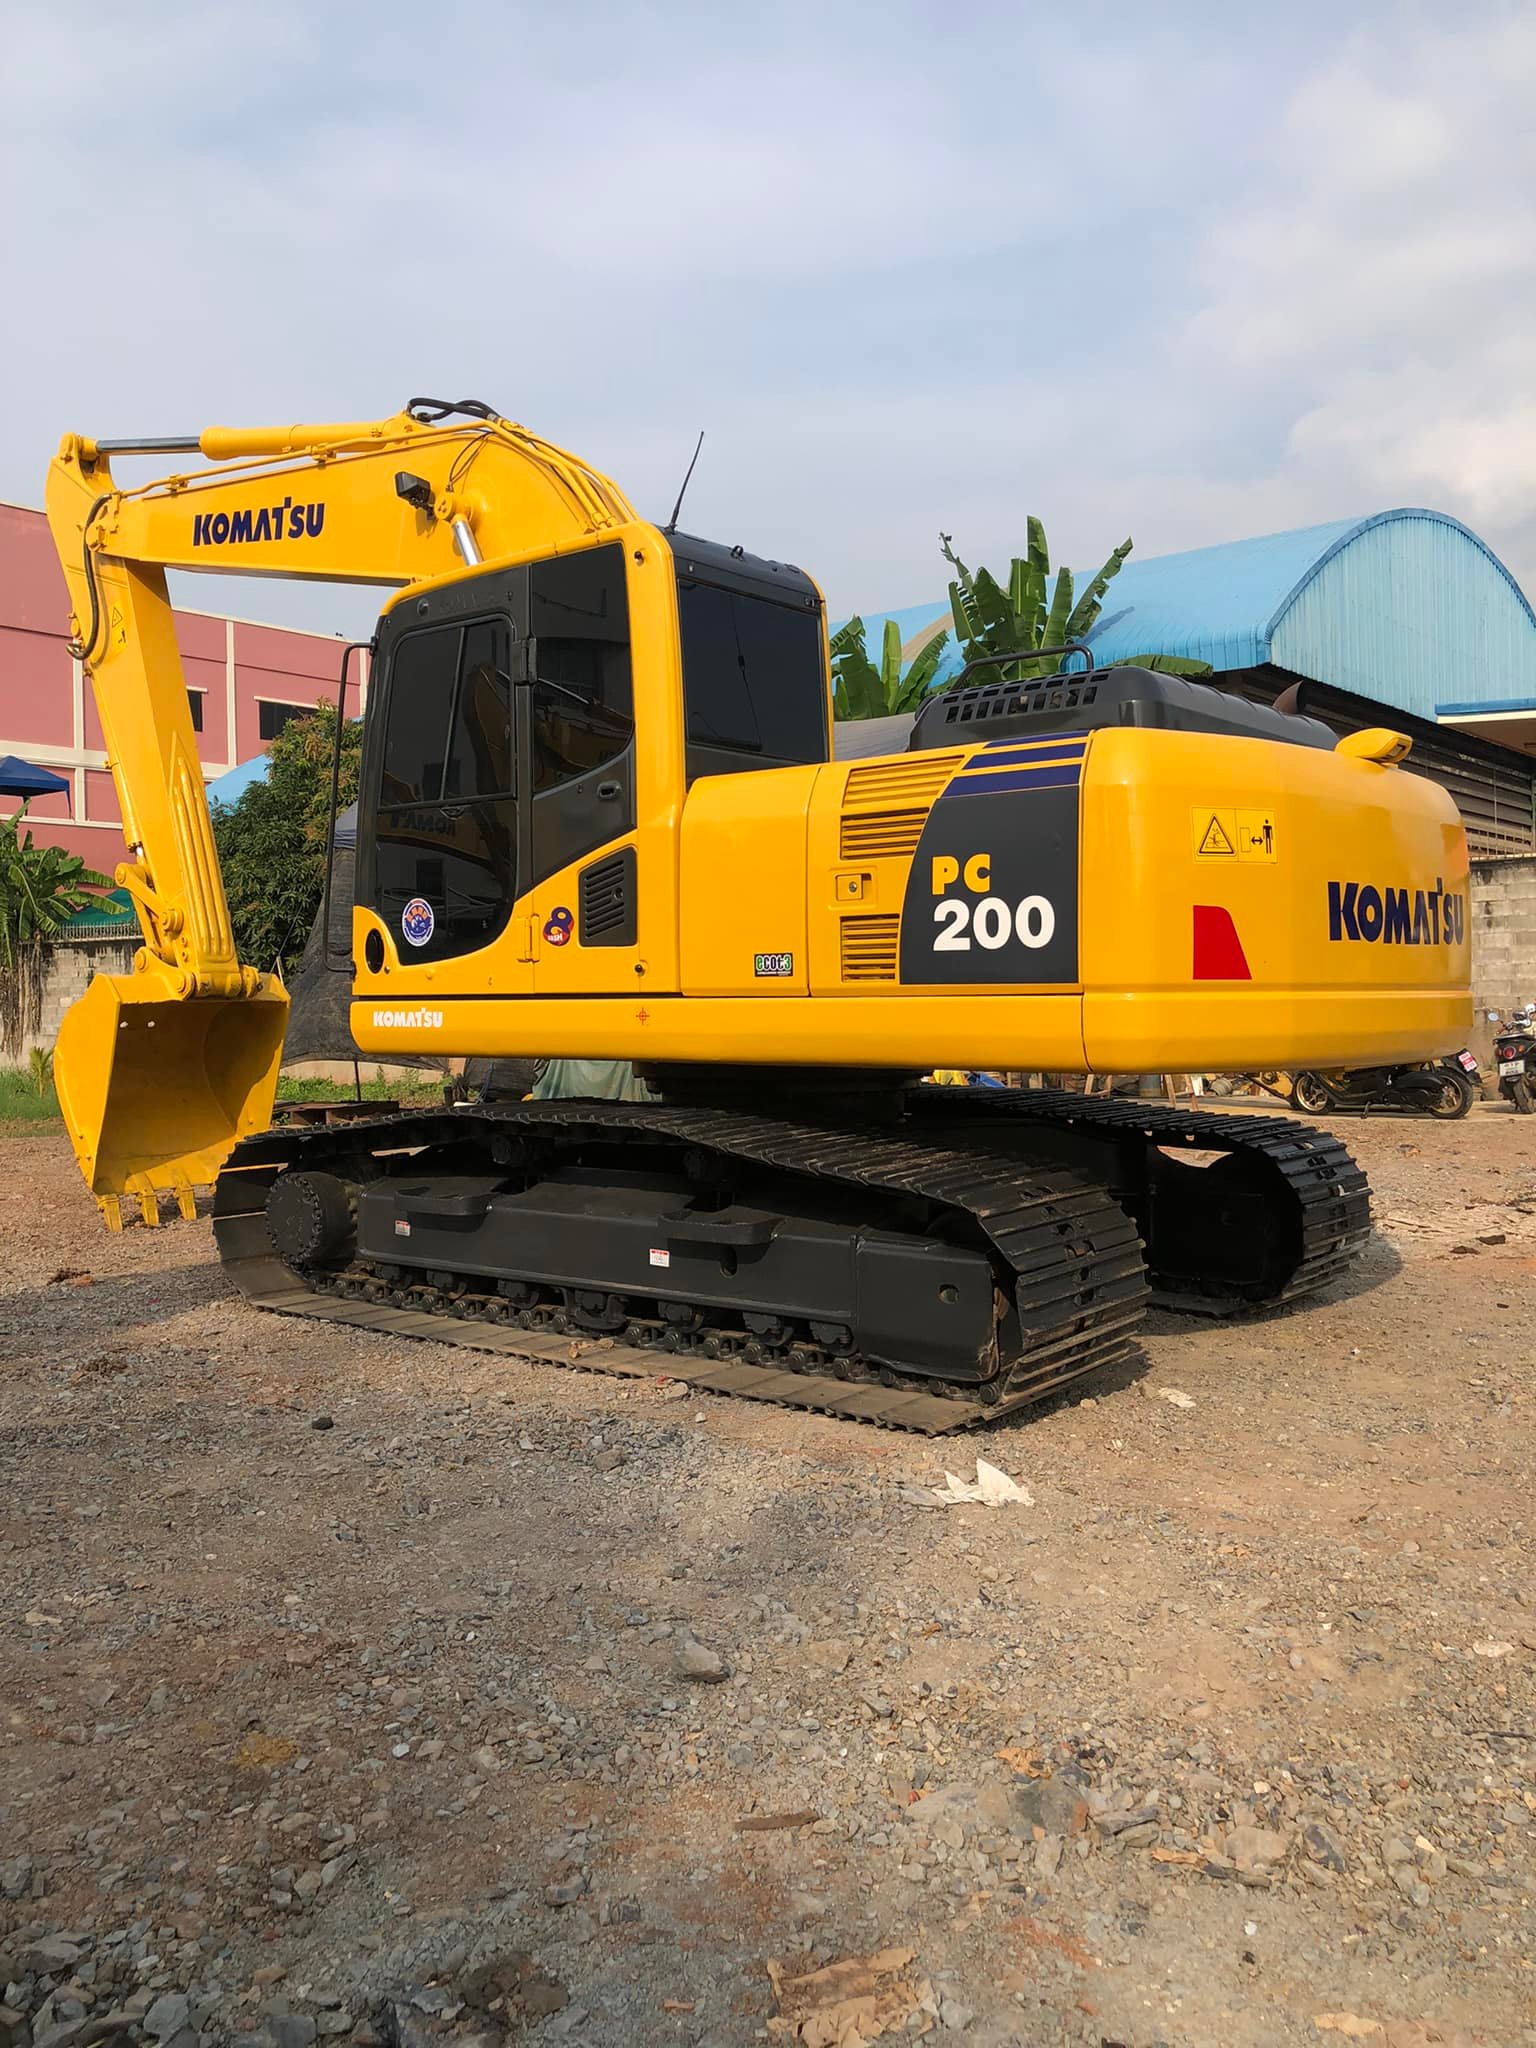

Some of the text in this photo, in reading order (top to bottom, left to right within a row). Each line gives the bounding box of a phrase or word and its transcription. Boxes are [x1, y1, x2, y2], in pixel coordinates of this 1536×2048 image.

[193, 496, 325, 547] KOMATSU
[932, 853, 991, 895] PC
[932, 895, 1055, 951] 200
[1327, 877, 1464, 945] KOMATSU
[756, 955, 792, 970] ecot3
[373, 1008, 443, 1028] KOMATSU
